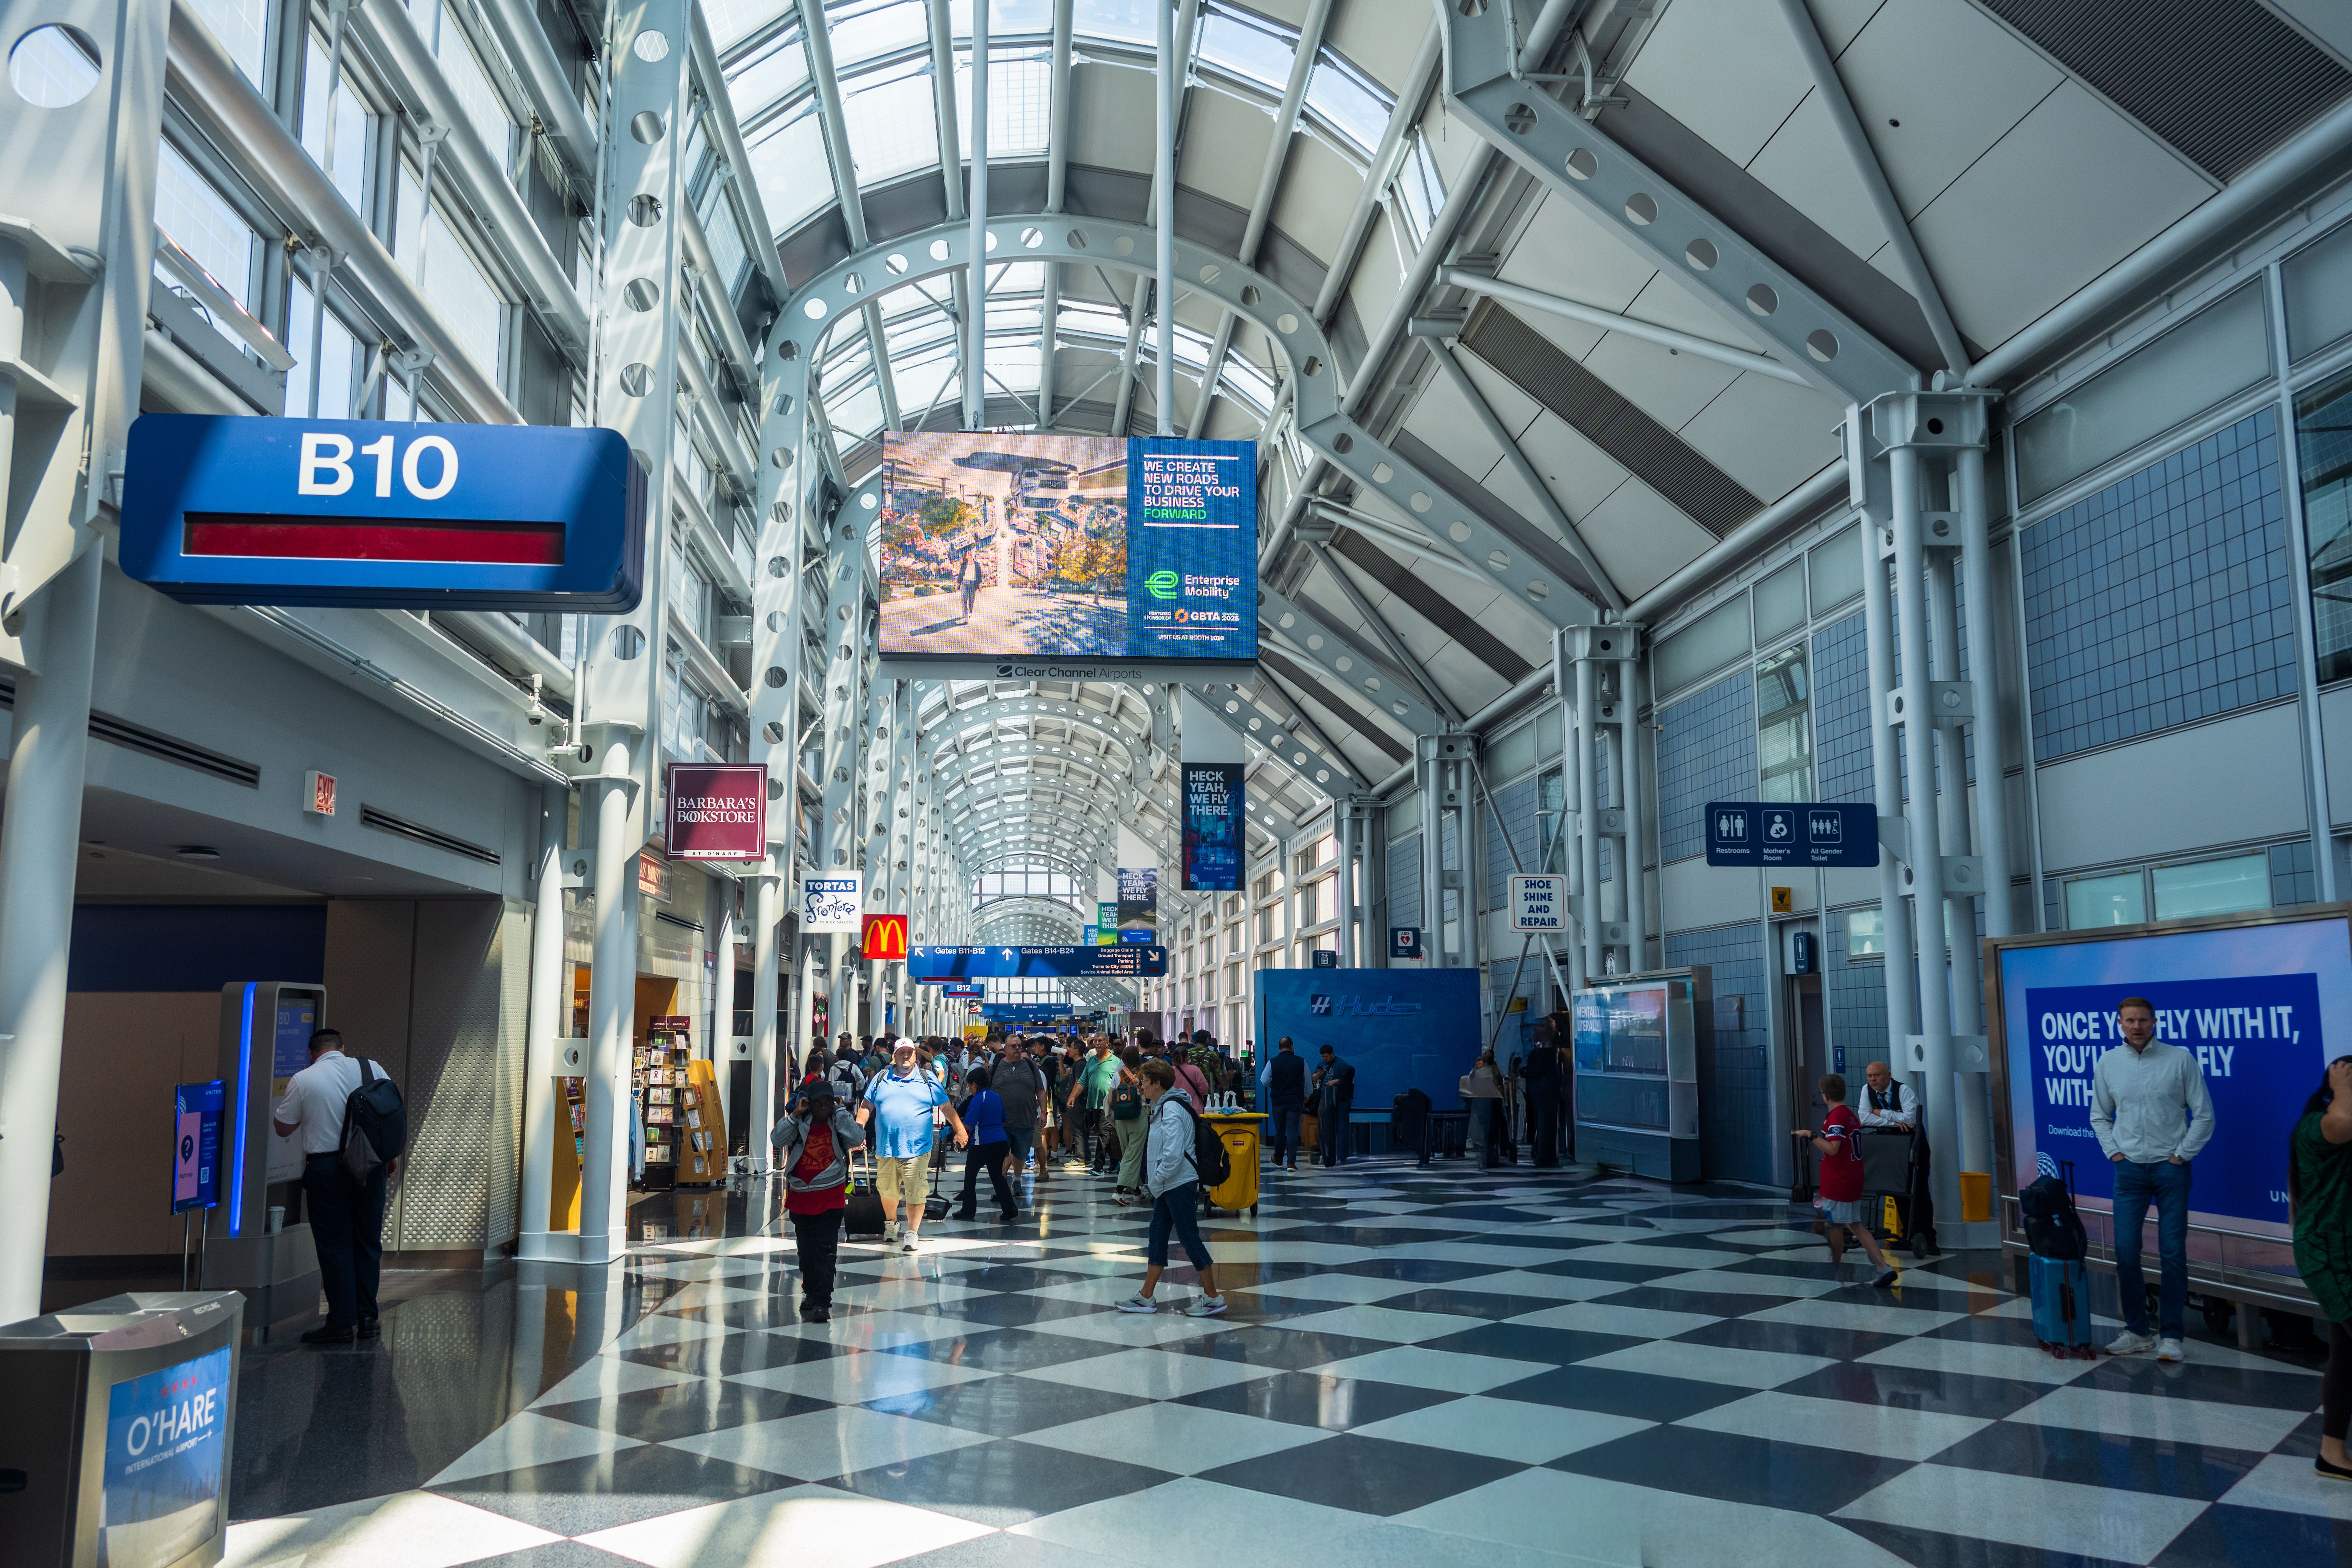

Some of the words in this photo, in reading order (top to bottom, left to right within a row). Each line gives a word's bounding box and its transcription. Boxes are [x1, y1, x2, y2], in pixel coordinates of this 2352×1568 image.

[298, 432, 459, 500] B10
[1144, 461, 1163, 471] WE
[1167, 462, 1215, 472] CREATE
[1144, 473, 1172, 483] NEW
[1177, 474, 1218, 485] ROADS
[1144, 485, 1161, 495] TO
[1165, 486, 1202, 496] DRIVE
[1205, 487, 1239, 497] YOUR
[1144, 497, 1204, 507] BUSINESS
[1144, 509, 1207, 519] FORWARD
[1185, 575, 1239, 586] Enterprise
[1191, 612, 1220, 621] GBTA
[1015, 667, 1046, 677] Clear
[1049, 667, 1095, 678] Channel
[1099, 668, 1142, 680] Airports
[1190, 771, 1224, 781] HECK
[1190, 783, 1227, 794] YEAH,
[677, 797, 756, 809] BARBARA'S
[1190, 794, 1209, 803] WE
[1212, 794, 1229, 804] FLY
[1190, 805, 1231, 815] THERE.
[677, 811, 755, 823] BOOKSTORE
[808, 882, 854, 891] TORTAS
[1524, 880, 1551, 889] SHOE
[1524, 892, 1553, 901] SHINE
[1528, 905, 1550, 913] AND
[1521, 917, 1557, 926] REPAIR
[1577, 1006, 1600, 1018] MENTALLY
[279, 1012, 289, 1025] B10
[2042, 1012, 2100, 1040] ONCE
[2155, 1009, 2190, 1039] FLY
[2195, 1007, 2264, 1039] WITH
[2270, 1006, 2300, 1044] IT,
[2043, 1044, 2106, 1073] YOU'L
[2201, 1046, 2234, 1077] FLY
[2045, 1078, 2094, 1106] WITH
[2048, 1125, 2081, 1138] Download
[2082, 1127, 2094, 1139] the
[193, 1302, 221, 1315] RECYCLING
[127, 1387, 216, 1456] O'HARE
[125, 1448, 174, 1475] INTERNATIONAL
[176, 1437, 198, 1454] AIRPORT
